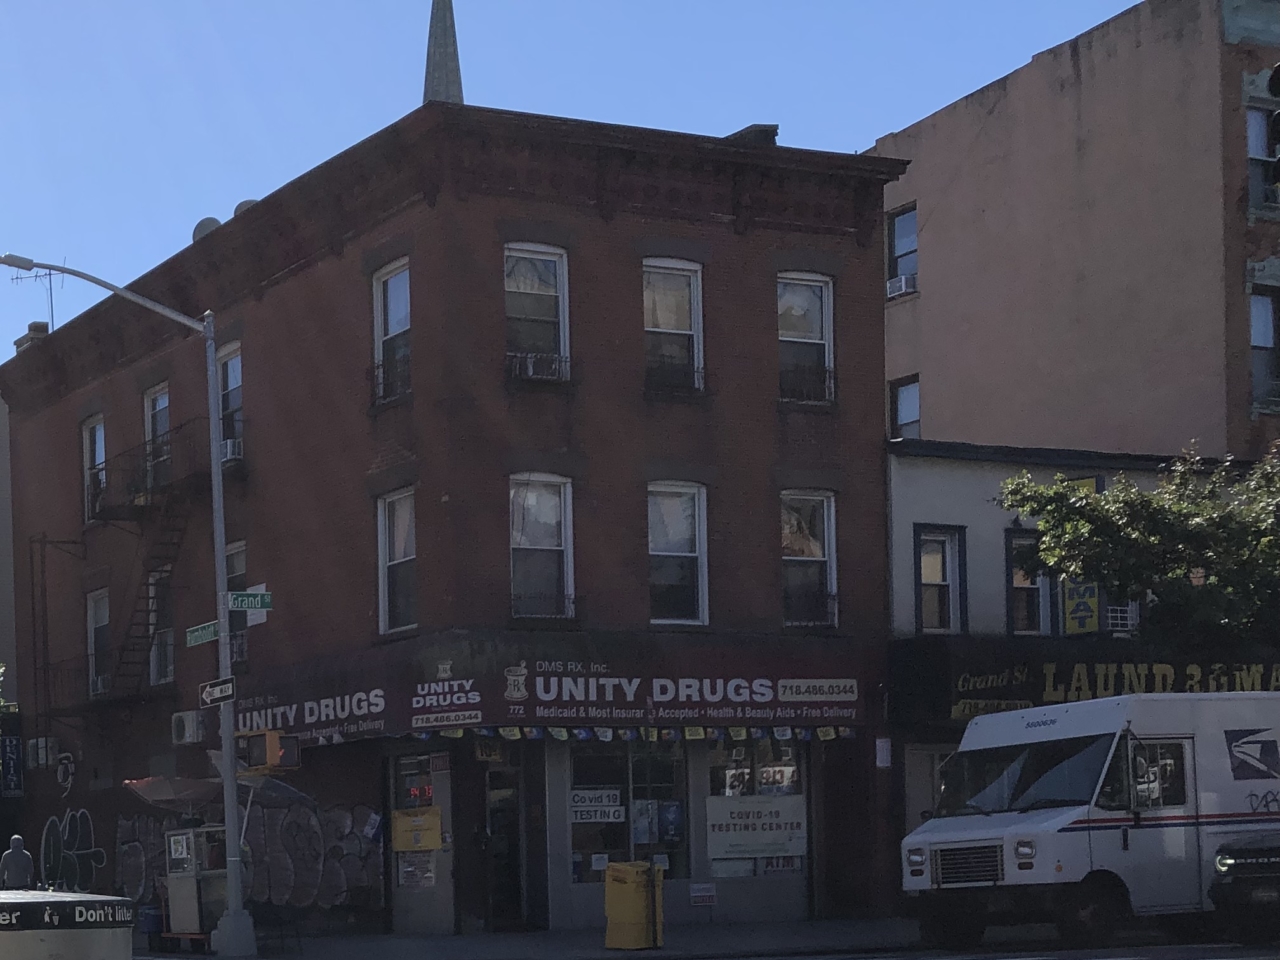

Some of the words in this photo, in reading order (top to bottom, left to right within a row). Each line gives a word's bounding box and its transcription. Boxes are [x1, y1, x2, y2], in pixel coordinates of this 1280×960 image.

[231, 594, 261, 609] Grand
[536, 660, 564, 672] DMS
[416, 679, 475, 696] UNITY
[957, 669, 1010, 692] Grand
[535, 677, 641, 702] UNITY
[652, 678, 775, 703] DRUGS
[780, 683, 855, 698] 718.486.0344
[412, 691, 482, 709] DRUGS
[238, 703, 298, 733] UNITY
[304, 689, 386, 725] DRUGS
[508, 705, 525, 715] 772
[535, 706, 577, 718] Medicaid
[579, 706, 586, 718] &
[589, 706, 609, 718] Most
[658, 706, 699, 721] Accepted
[706, 706, 734, 719] Health
[736, 707, 743, 719] &
[745, 707, 774, 721] Beauty
[776, 707, 795, 719] Aids
[802, 707, 820, 719] Free
[823, 707, 856, 721] Delivery
[344, 722, 359, 734] Free
[359, 718, 386, 732] Delivery
[414, 713, 479, 726] 718.486.0344
[605, 793, 618, 804] 19
[711, 823, 757, 833] TESTING
[761, 822, 802, 831] CENTER
[74, 904, 113, 922] Don't
